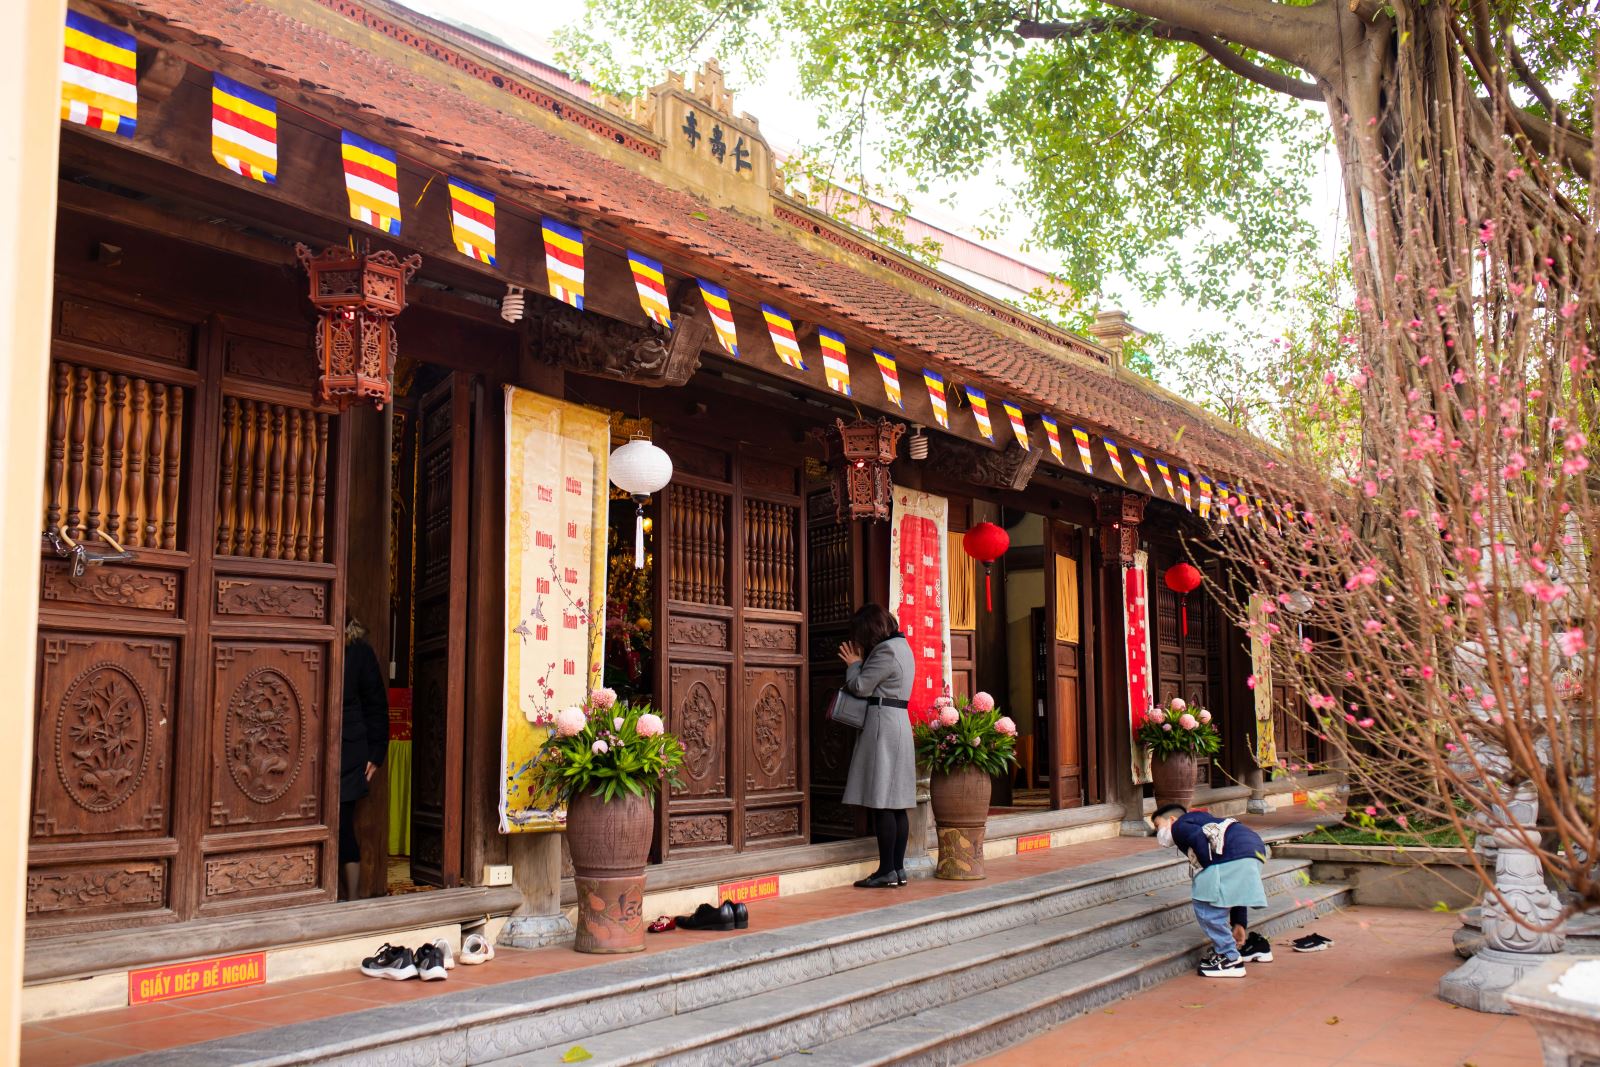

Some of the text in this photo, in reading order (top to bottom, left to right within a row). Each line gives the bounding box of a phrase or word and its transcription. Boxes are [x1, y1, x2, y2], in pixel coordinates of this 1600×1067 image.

[536, 530, 553, 550] Mừng
[536, 577, 550, 594] Năm
[563, 612, 578, 630] Thanh
[536, 624, 548, 641] Mới
[140, 959, 259, 998] GIẤY DÉP ĐỂ NGOÀI
